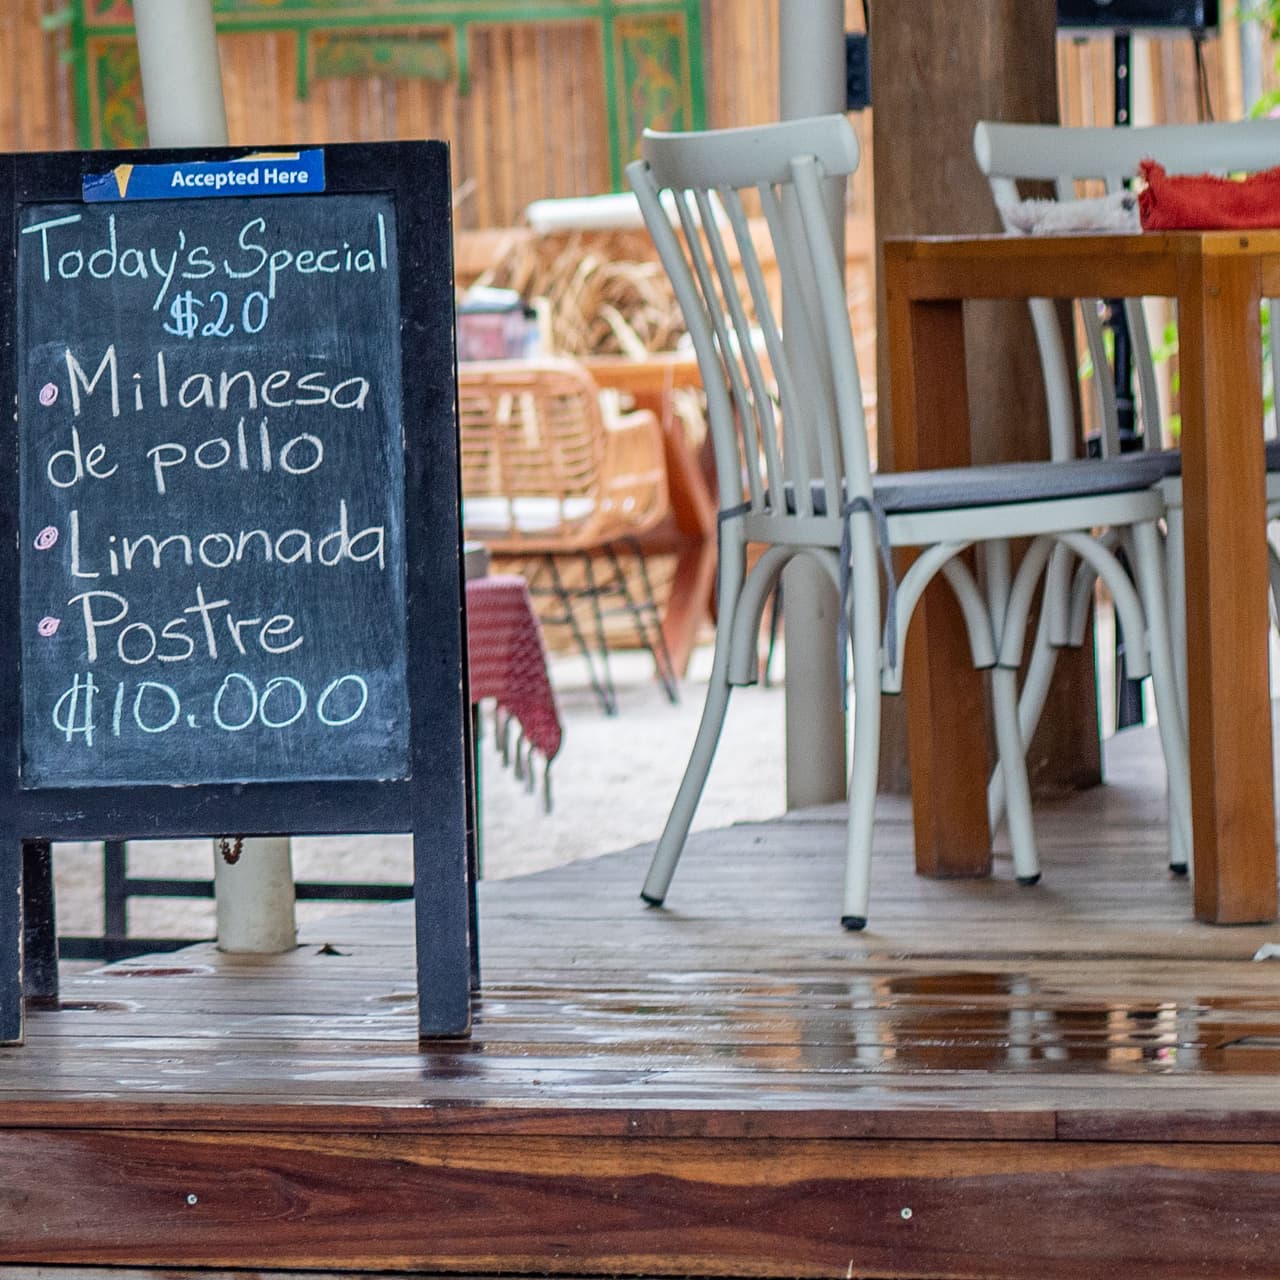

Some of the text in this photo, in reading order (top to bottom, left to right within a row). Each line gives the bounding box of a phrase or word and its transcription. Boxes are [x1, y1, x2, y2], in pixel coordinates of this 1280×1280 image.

[171, 167, 309, 189] Accepted Here
[21, 213, 388, 311] Today's Special
[162, 290, 269, 340] $20
[65, 344, 370, 416] Milanesa
[47, 417, 324, 495] de pollo
[69, 499, 384, 578] Limonada
[67, 583, 304, 664] Postre
